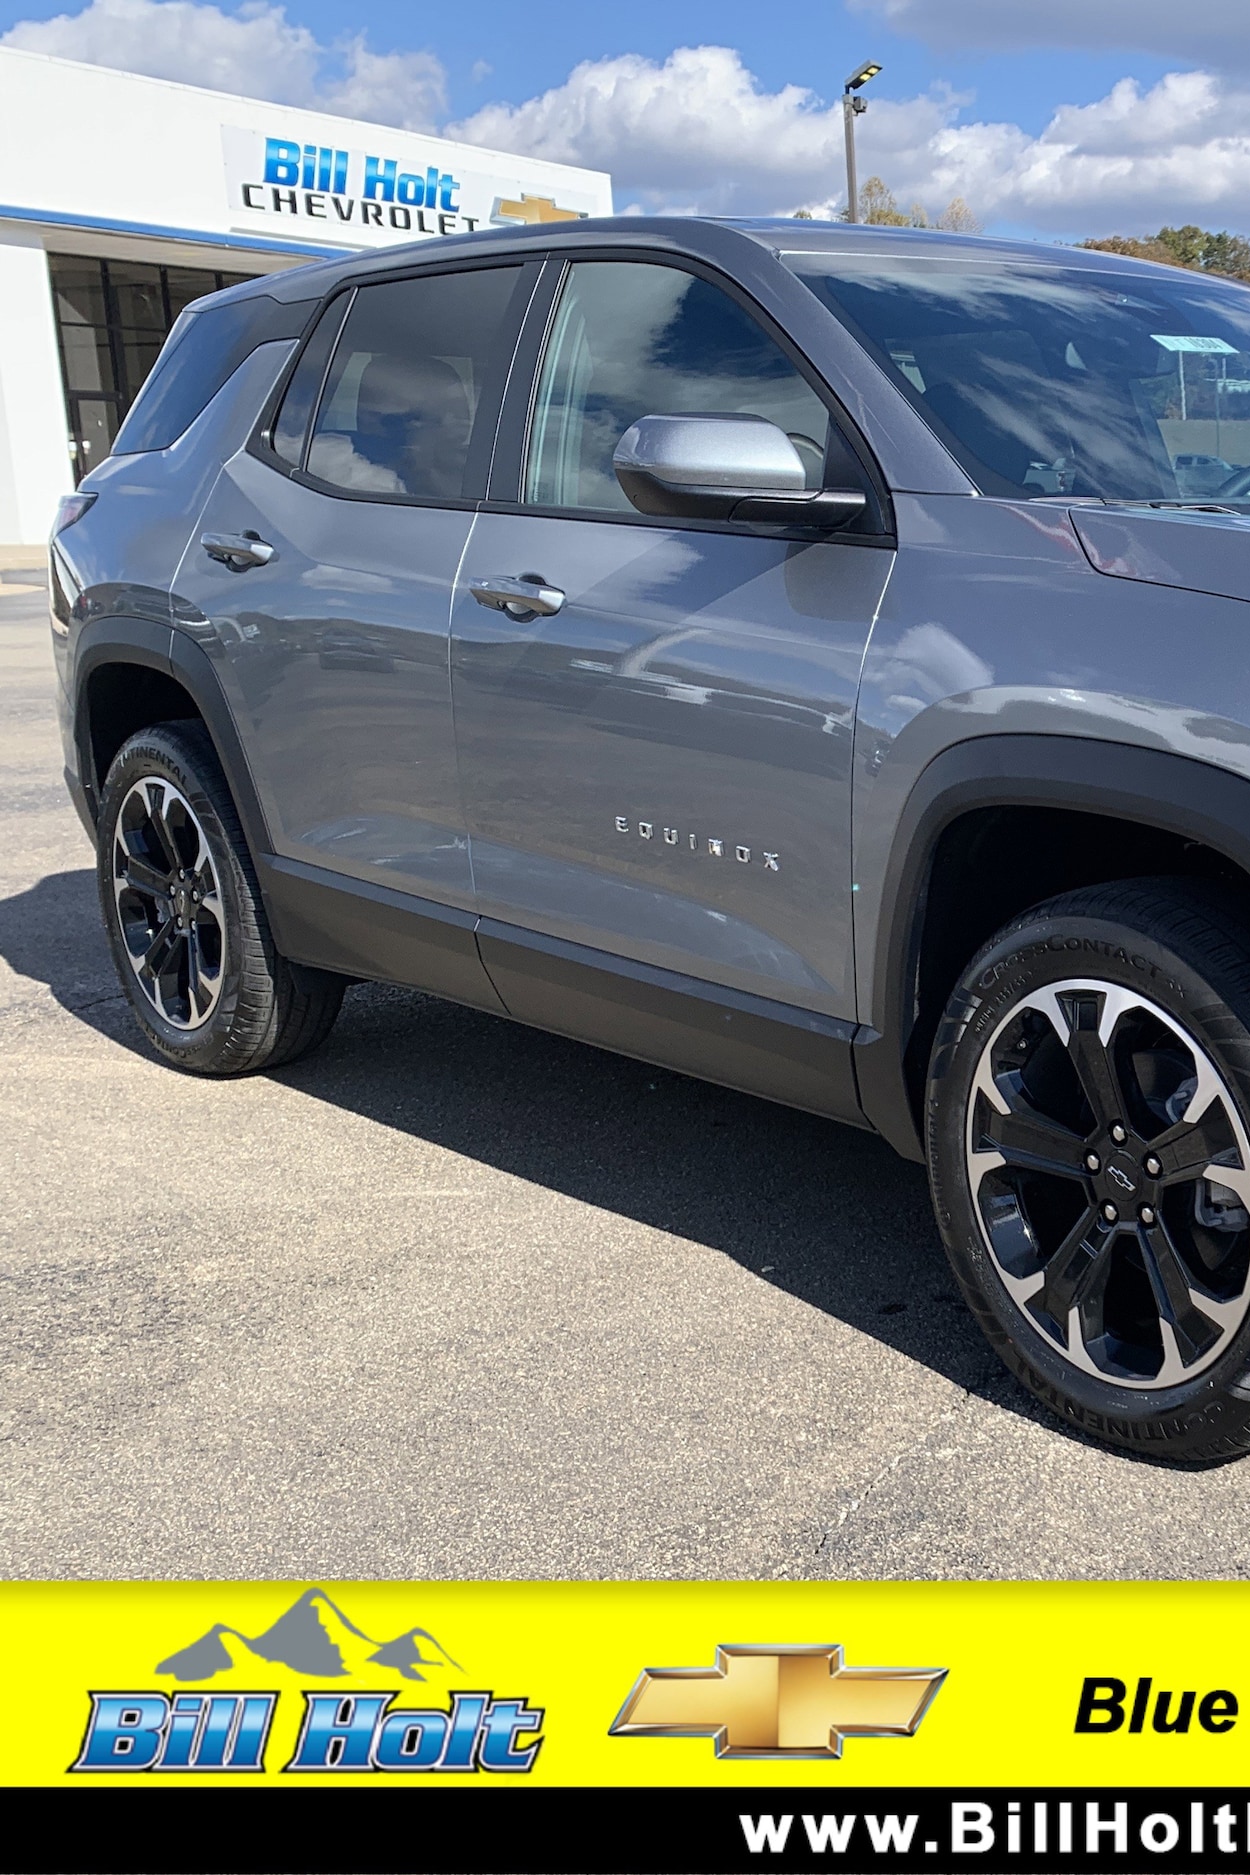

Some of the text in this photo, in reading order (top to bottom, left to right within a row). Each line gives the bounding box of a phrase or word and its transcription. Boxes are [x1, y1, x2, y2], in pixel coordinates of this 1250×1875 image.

[263, 137, 461, 213] Bill Holt
[241, 183, 480, 235] CHEVROLET
[614, 816, 779, 872] EQUINOX
